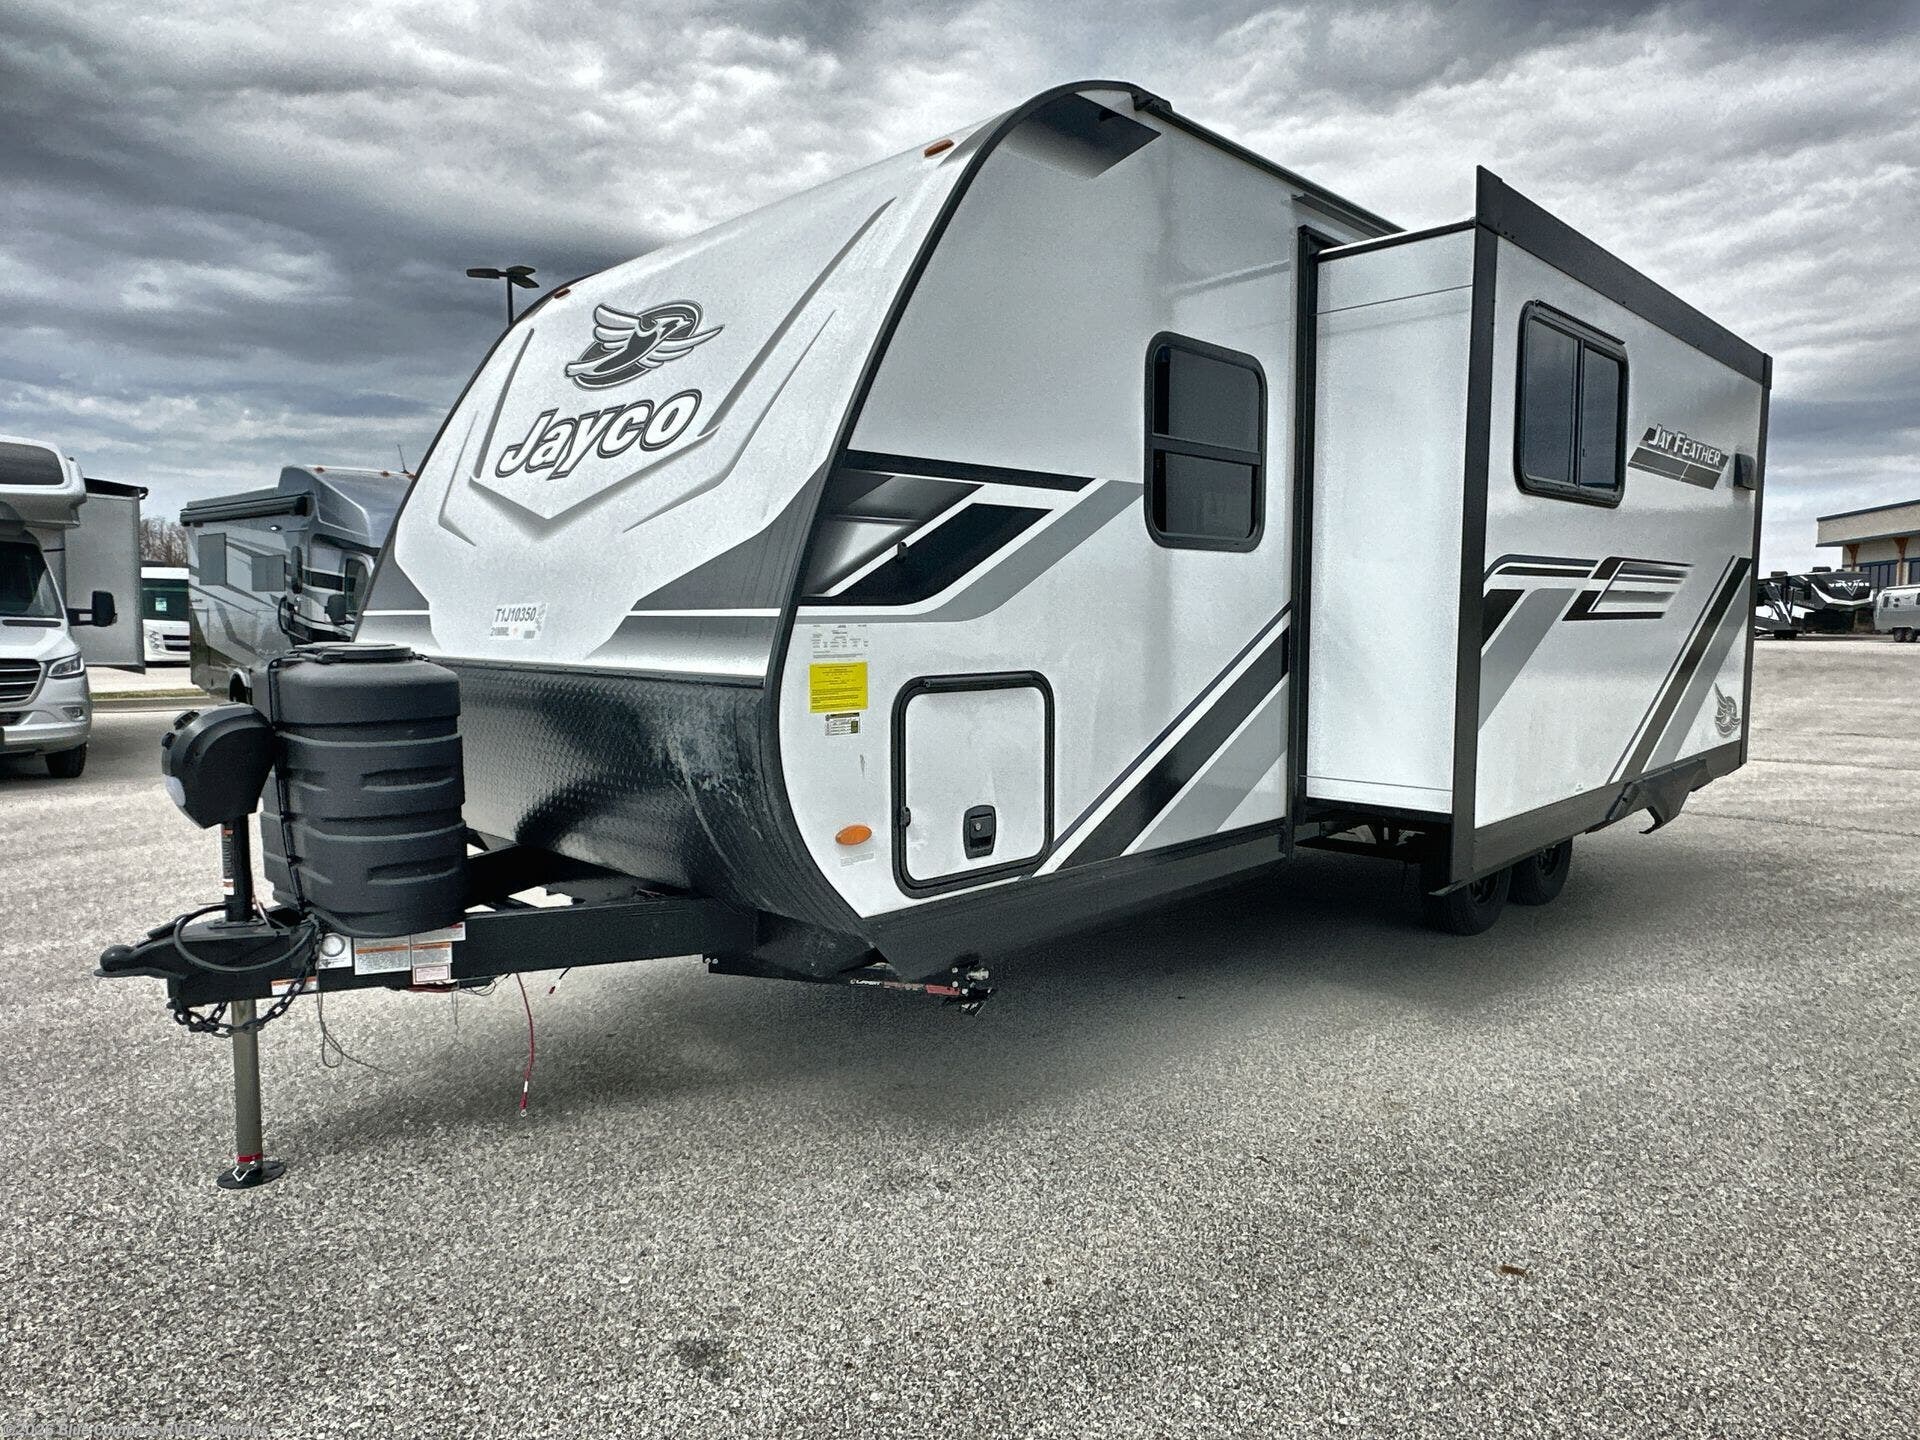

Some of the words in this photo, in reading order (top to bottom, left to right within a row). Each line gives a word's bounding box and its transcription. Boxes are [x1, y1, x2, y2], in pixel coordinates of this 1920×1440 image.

[495, 389, 702, 481] Jayco
[1647, 423, 1673, 450] JAY
[1673, 431, 1722, 467] FEATHER
[495, 607, 537, 622] T1J10350
